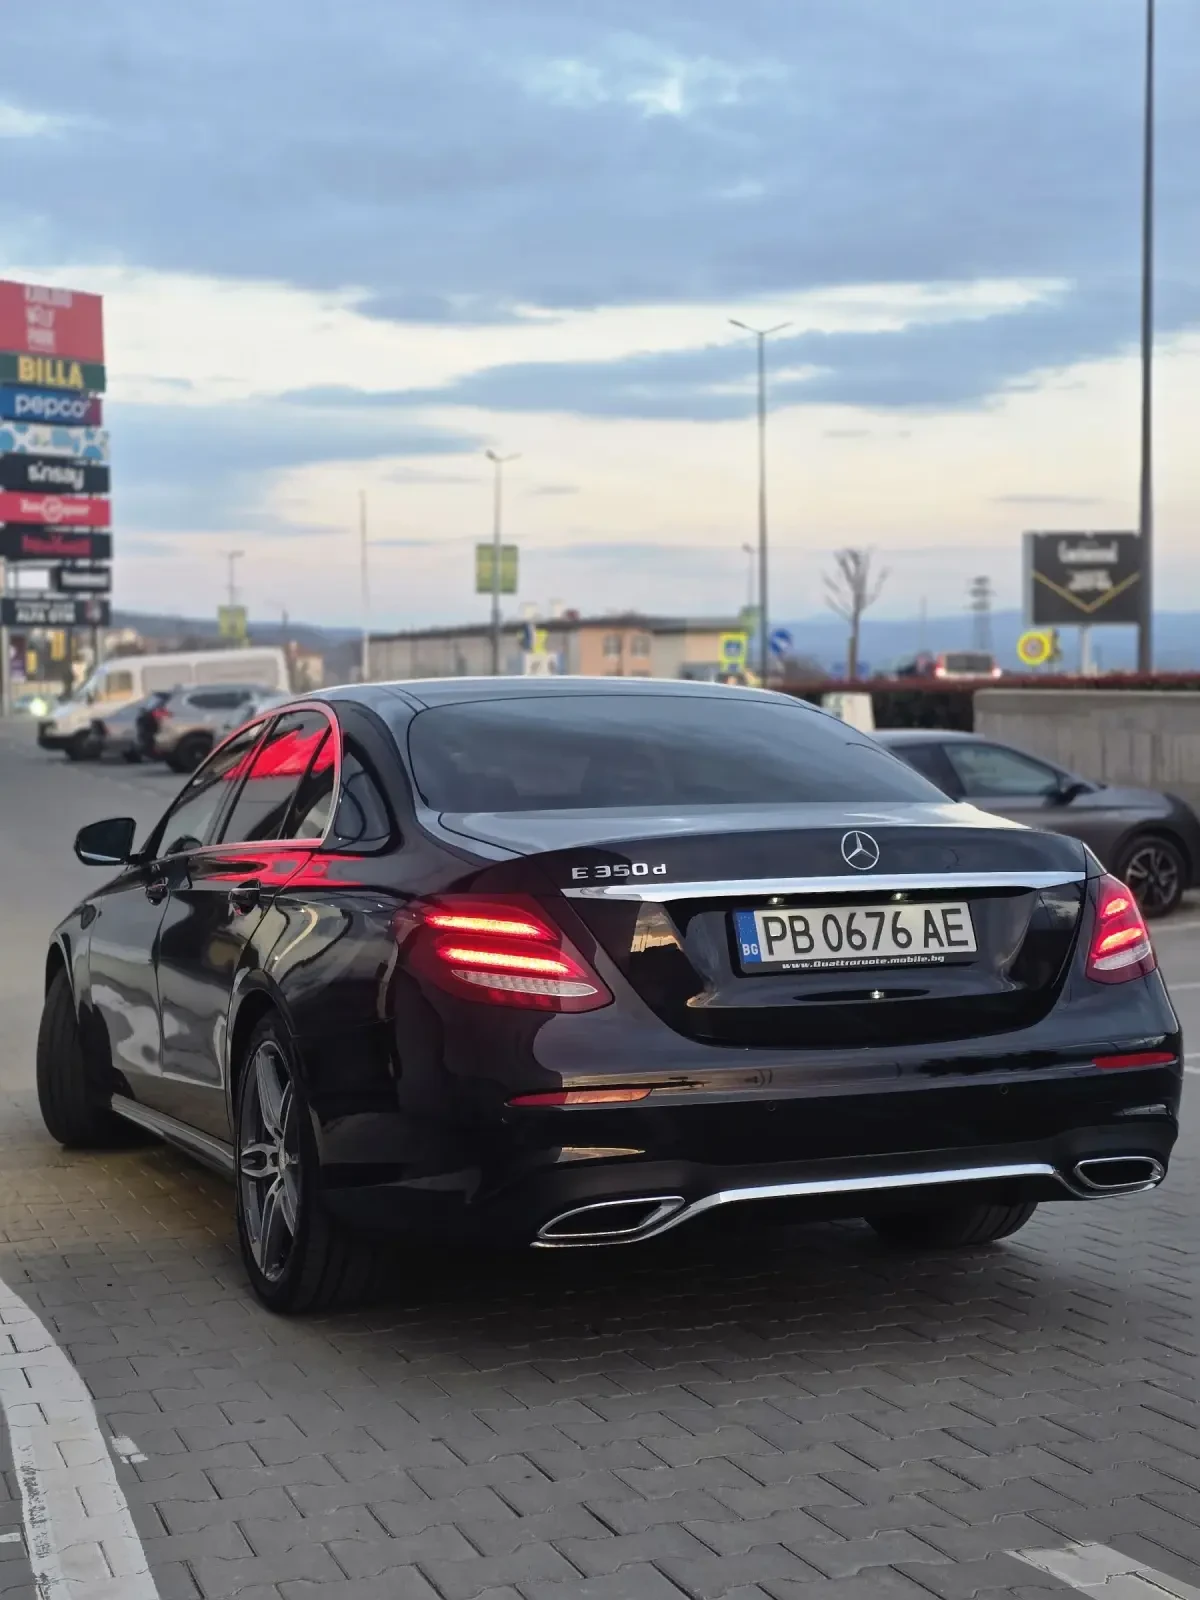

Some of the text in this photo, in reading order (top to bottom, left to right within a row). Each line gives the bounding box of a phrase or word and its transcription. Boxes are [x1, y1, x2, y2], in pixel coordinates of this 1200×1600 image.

[18, 355, 83, 389] BILLA
[15, 394, 90, 418] pepco
[762, 908, 969, 955] PB 0676 AE
[742, 943, 759, 956] BG
